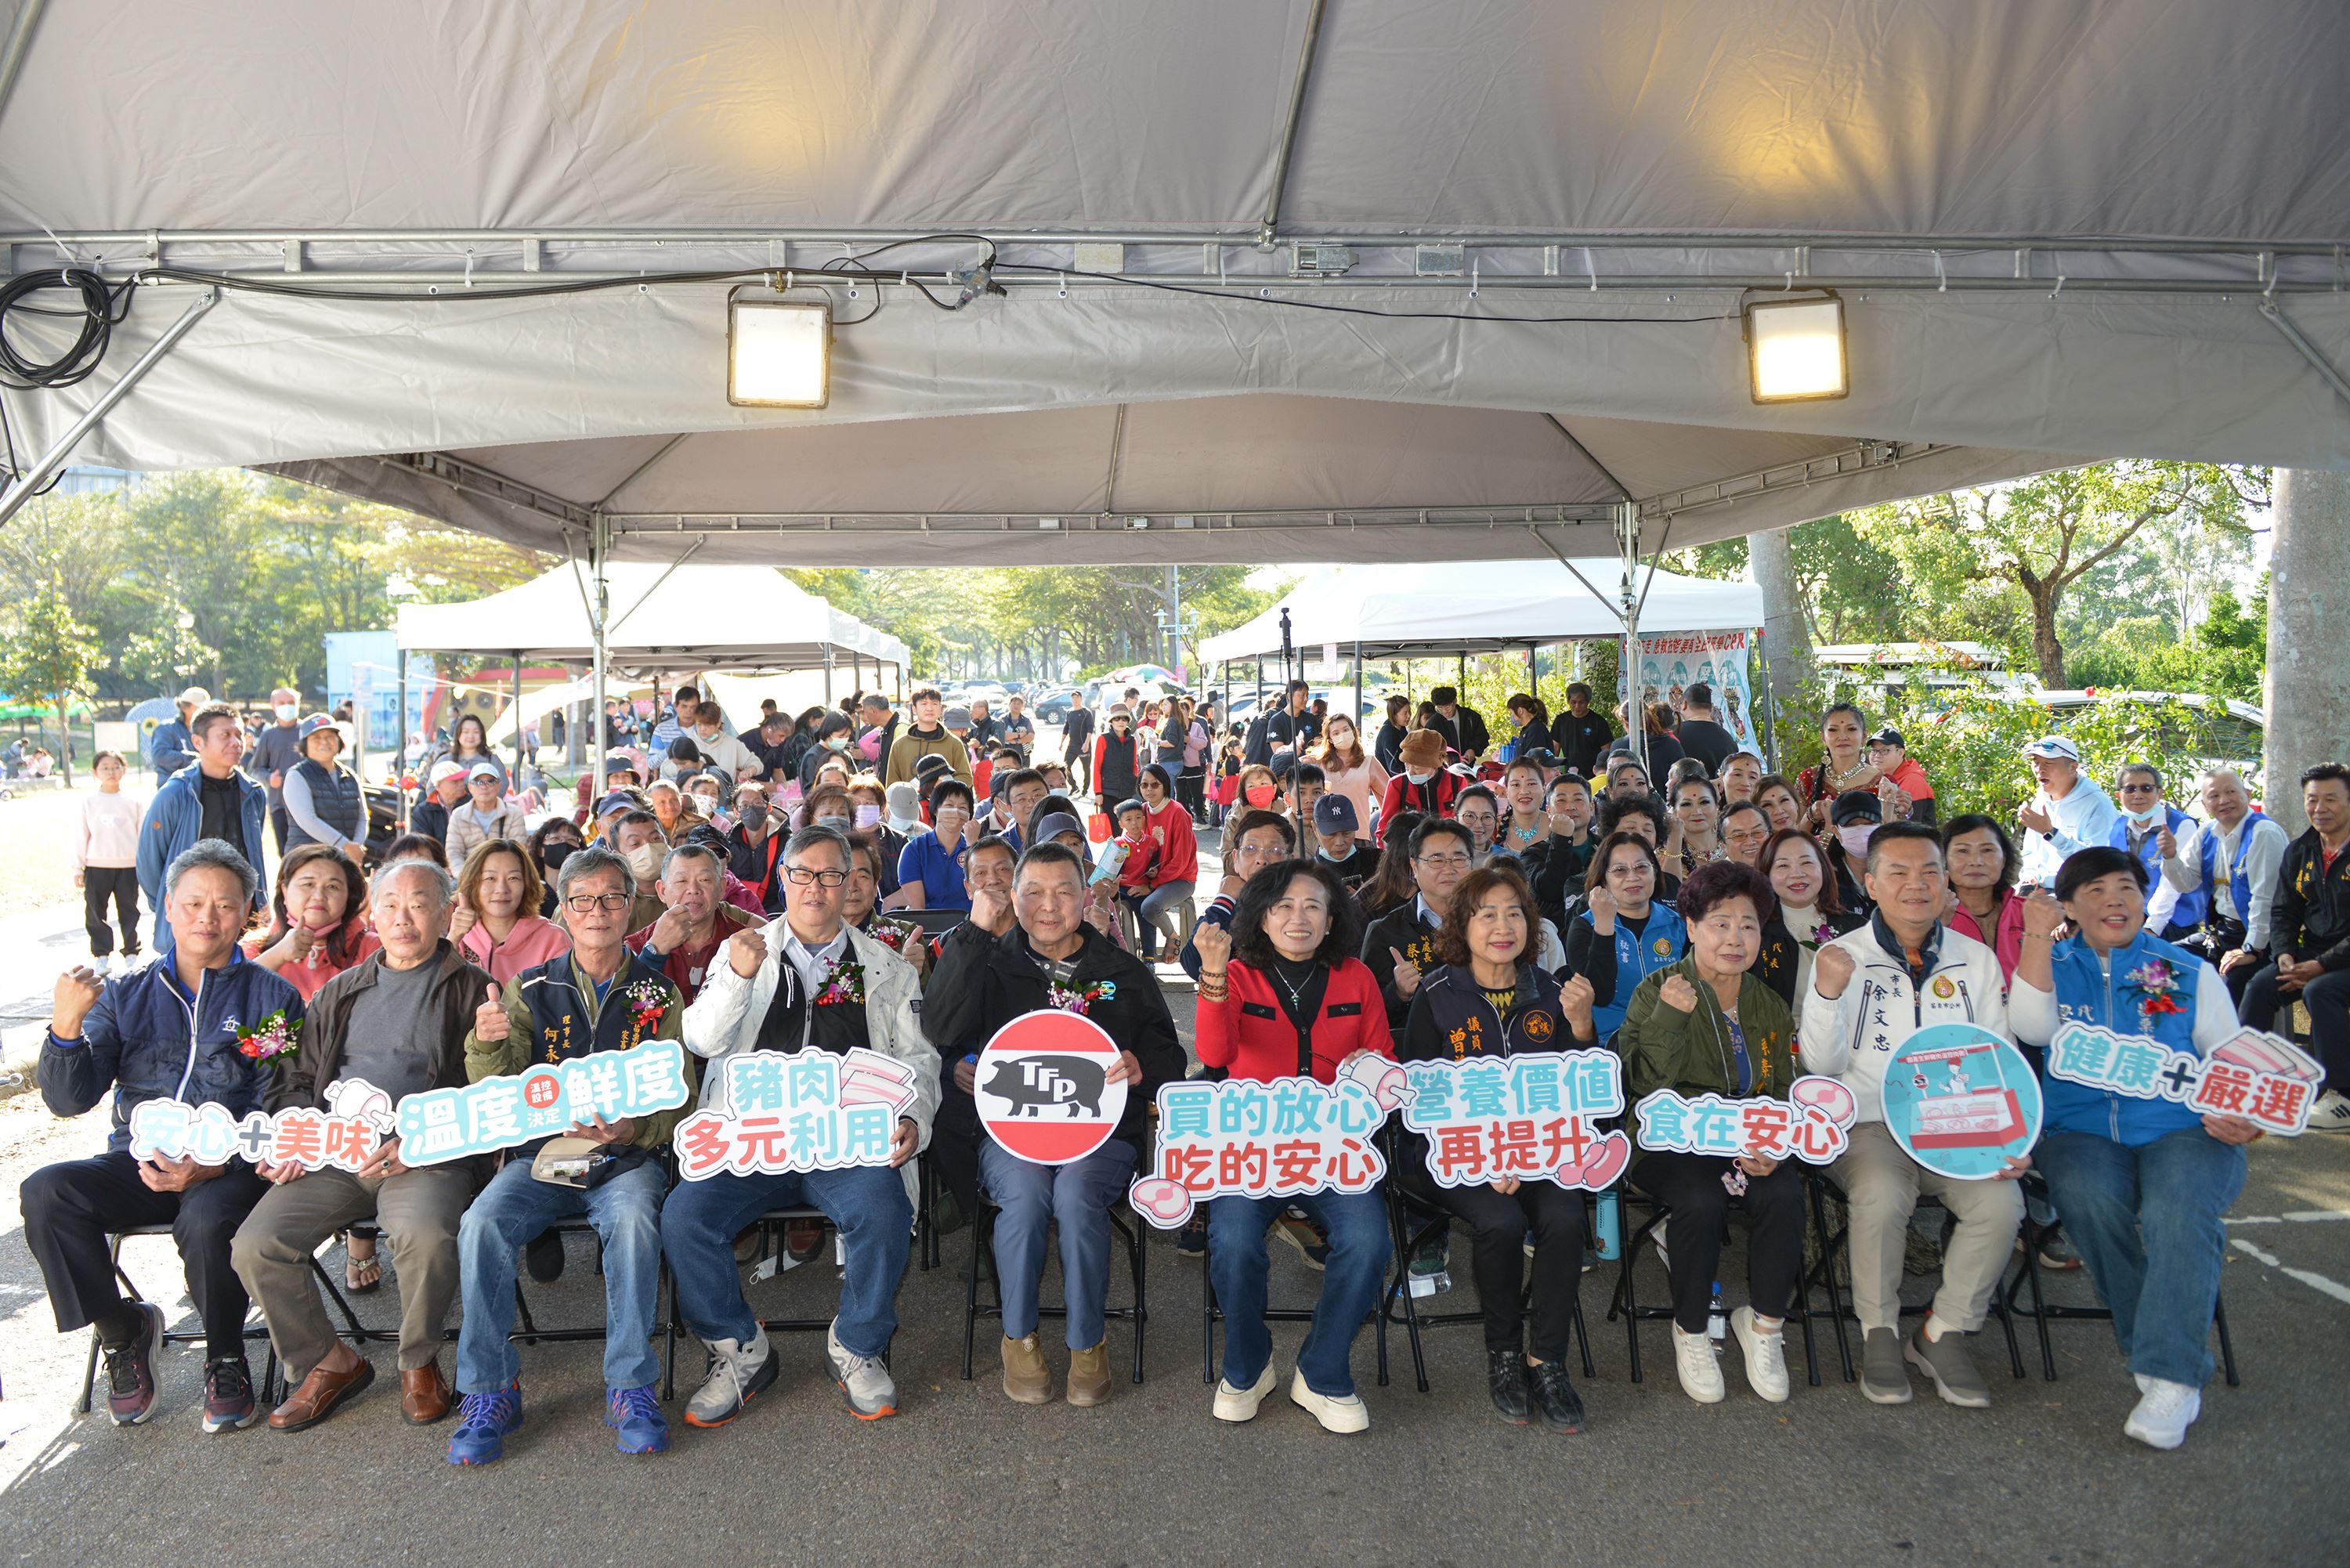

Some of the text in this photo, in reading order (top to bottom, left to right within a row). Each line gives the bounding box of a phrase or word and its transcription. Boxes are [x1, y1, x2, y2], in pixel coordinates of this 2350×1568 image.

[1332, 806, 1341, 815] NY
[1889, 974, 1904, 999] 市長
[562, 1014, 571, 1049] 理事長
[1449, 1027, 1467, 1061] 曾
[1466, 1016, 1483, 1051] 議員
[1871, 984, 1889, 1052] 余文忠
[544, 1027, 560, 1066] 何永
[406, 1050, 678, 1156] 溫度 鮮度
[734, 1057, 834, 1112] 豬肉
[1018, 1061, 1077, 1102] TFP
[1409, 1058, 1614, 1122] 營養價值
[2059, 1029, 2307, 1127] 健康+嚴選
[139, 1107, 371, 1165] 安心+美味
[527, 1107, 561, 1129] 決定
[684, 1108, 890, 1171] 多元利用
[1166, 1085, 1377, 1140] 買的放心
[1644, 1097, 1839, 1155] 食在安心
[1165, 1137, 1376, 1191] 吃的安心
[1437, 1115, 1591, 1176] 再提升
